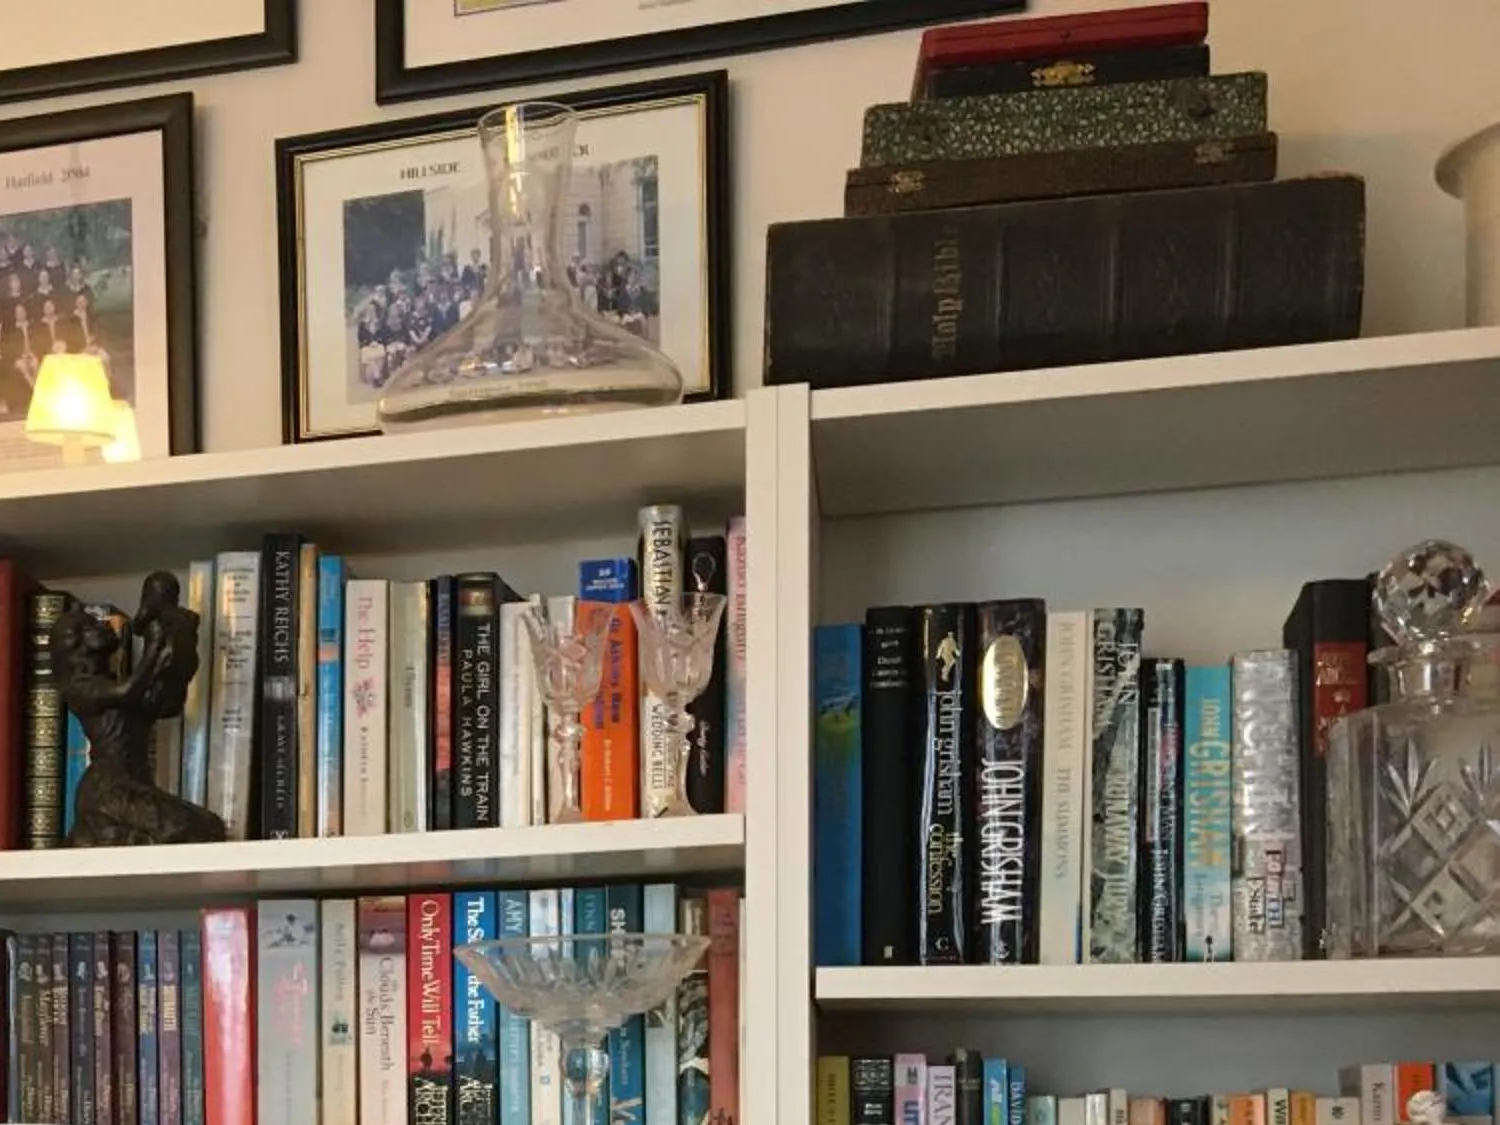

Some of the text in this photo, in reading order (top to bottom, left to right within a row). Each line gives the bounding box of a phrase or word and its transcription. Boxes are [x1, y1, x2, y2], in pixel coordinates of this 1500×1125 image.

[400, 160, 461, 181] HILLSIDE
[933, 222, 964, 360] Holy Bible
[272, 551, 290, 664] KATHY REICHS
[653, 519, 674, 607] SEBASTIAN
[353, 628, 377, 670] Help
[1058, 621, 1076, 752] JOHN GRISHAM
[1094, 621, 1116, 728] GRISHAM
[1116, 641, 1139, 705] JOHN
[459, 716, 474, 798] HAWKINS
[475, 623, 491, 821] THE GIRL ON THE TRAIN
[651, 703, 664, 758] WEDDING
[931, 690, 963, 816] john grisham
[979, 757, 1025, 817] JOHN
[1105, 772, 1129, 865] RUNAWAY
[1189, 700, 1230, 868] JOHN GRISHAM
[927, 822, 953, 916] confession
[980, 817, 1025, 925] GRISHAM
[1053, 800, 1071, 881] SUMMONS
[504, 899, 524, 933] AMY
[379, 957, 396, 1072] Clouds Beneath
[419, 899, 440, 1044] Only Time Will Tell
[467, 896, 485, 1044] The the Father
[364, 1007, 380, 1036] Sun
[1010, 1081, 1024, 1125] DAVID
